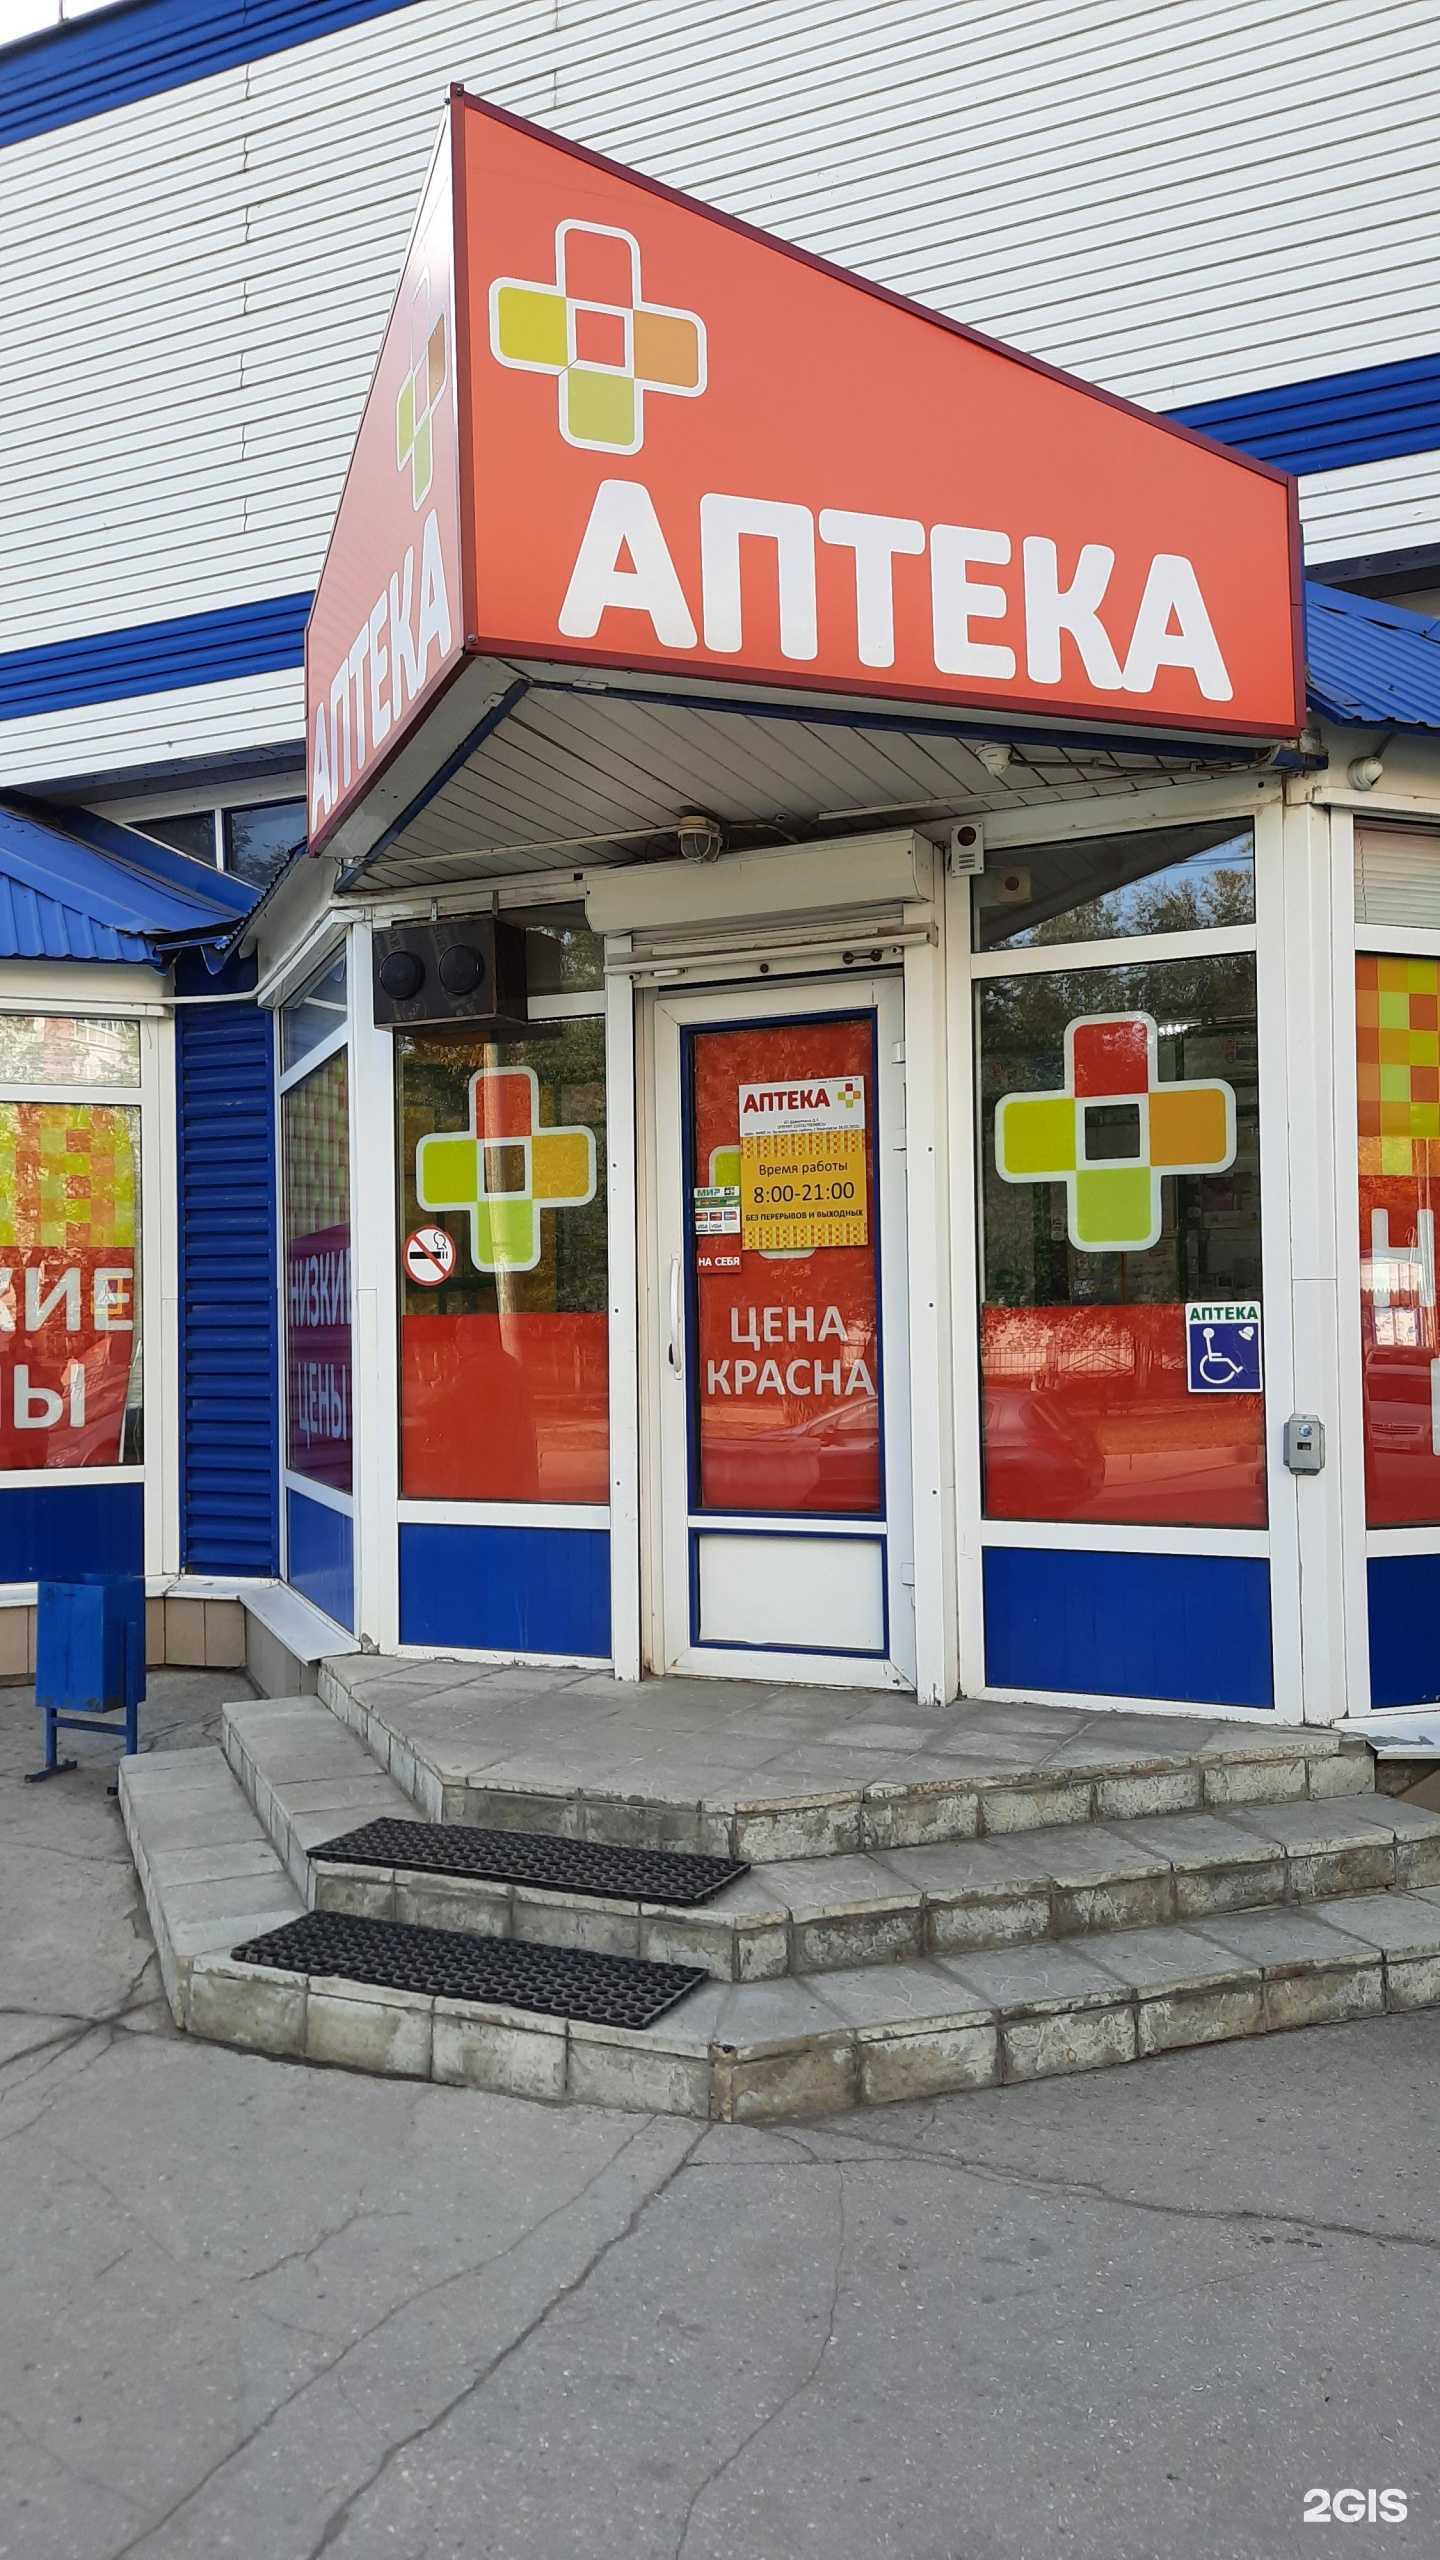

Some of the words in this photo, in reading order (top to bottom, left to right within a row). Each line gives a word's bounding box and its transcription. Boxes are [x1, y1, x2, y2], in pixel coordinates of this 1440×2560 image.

[558, 479, 1232, 702] АПТЕКА
[312, 509, 451, 835] АПТЕКА
[743, 1087, 831, 1113] АПТЕКА
[759, 1164, 798, 1177] Время
[802, 1160, 848, 1175] работы
[753, 1182, 855, 1203] 8:00-21:00
[760, 1211, 807, 1220] ПЕРЕРЫВОВ
[817, 1209, 863, 1218] ВЫХОДНЫХ
[698, 1257, 712, 1266] НА
[715, 1257, 740, 1266] СЕБЯ
[1190, 1306, 1258, 1321] АПТЕКА
[731, 1306, 849, 1351] ЦЕНА
[707, 1359, 876, 1396] КРАСНА
[299, 1361, 347, 1449] ЦЕНЫ
